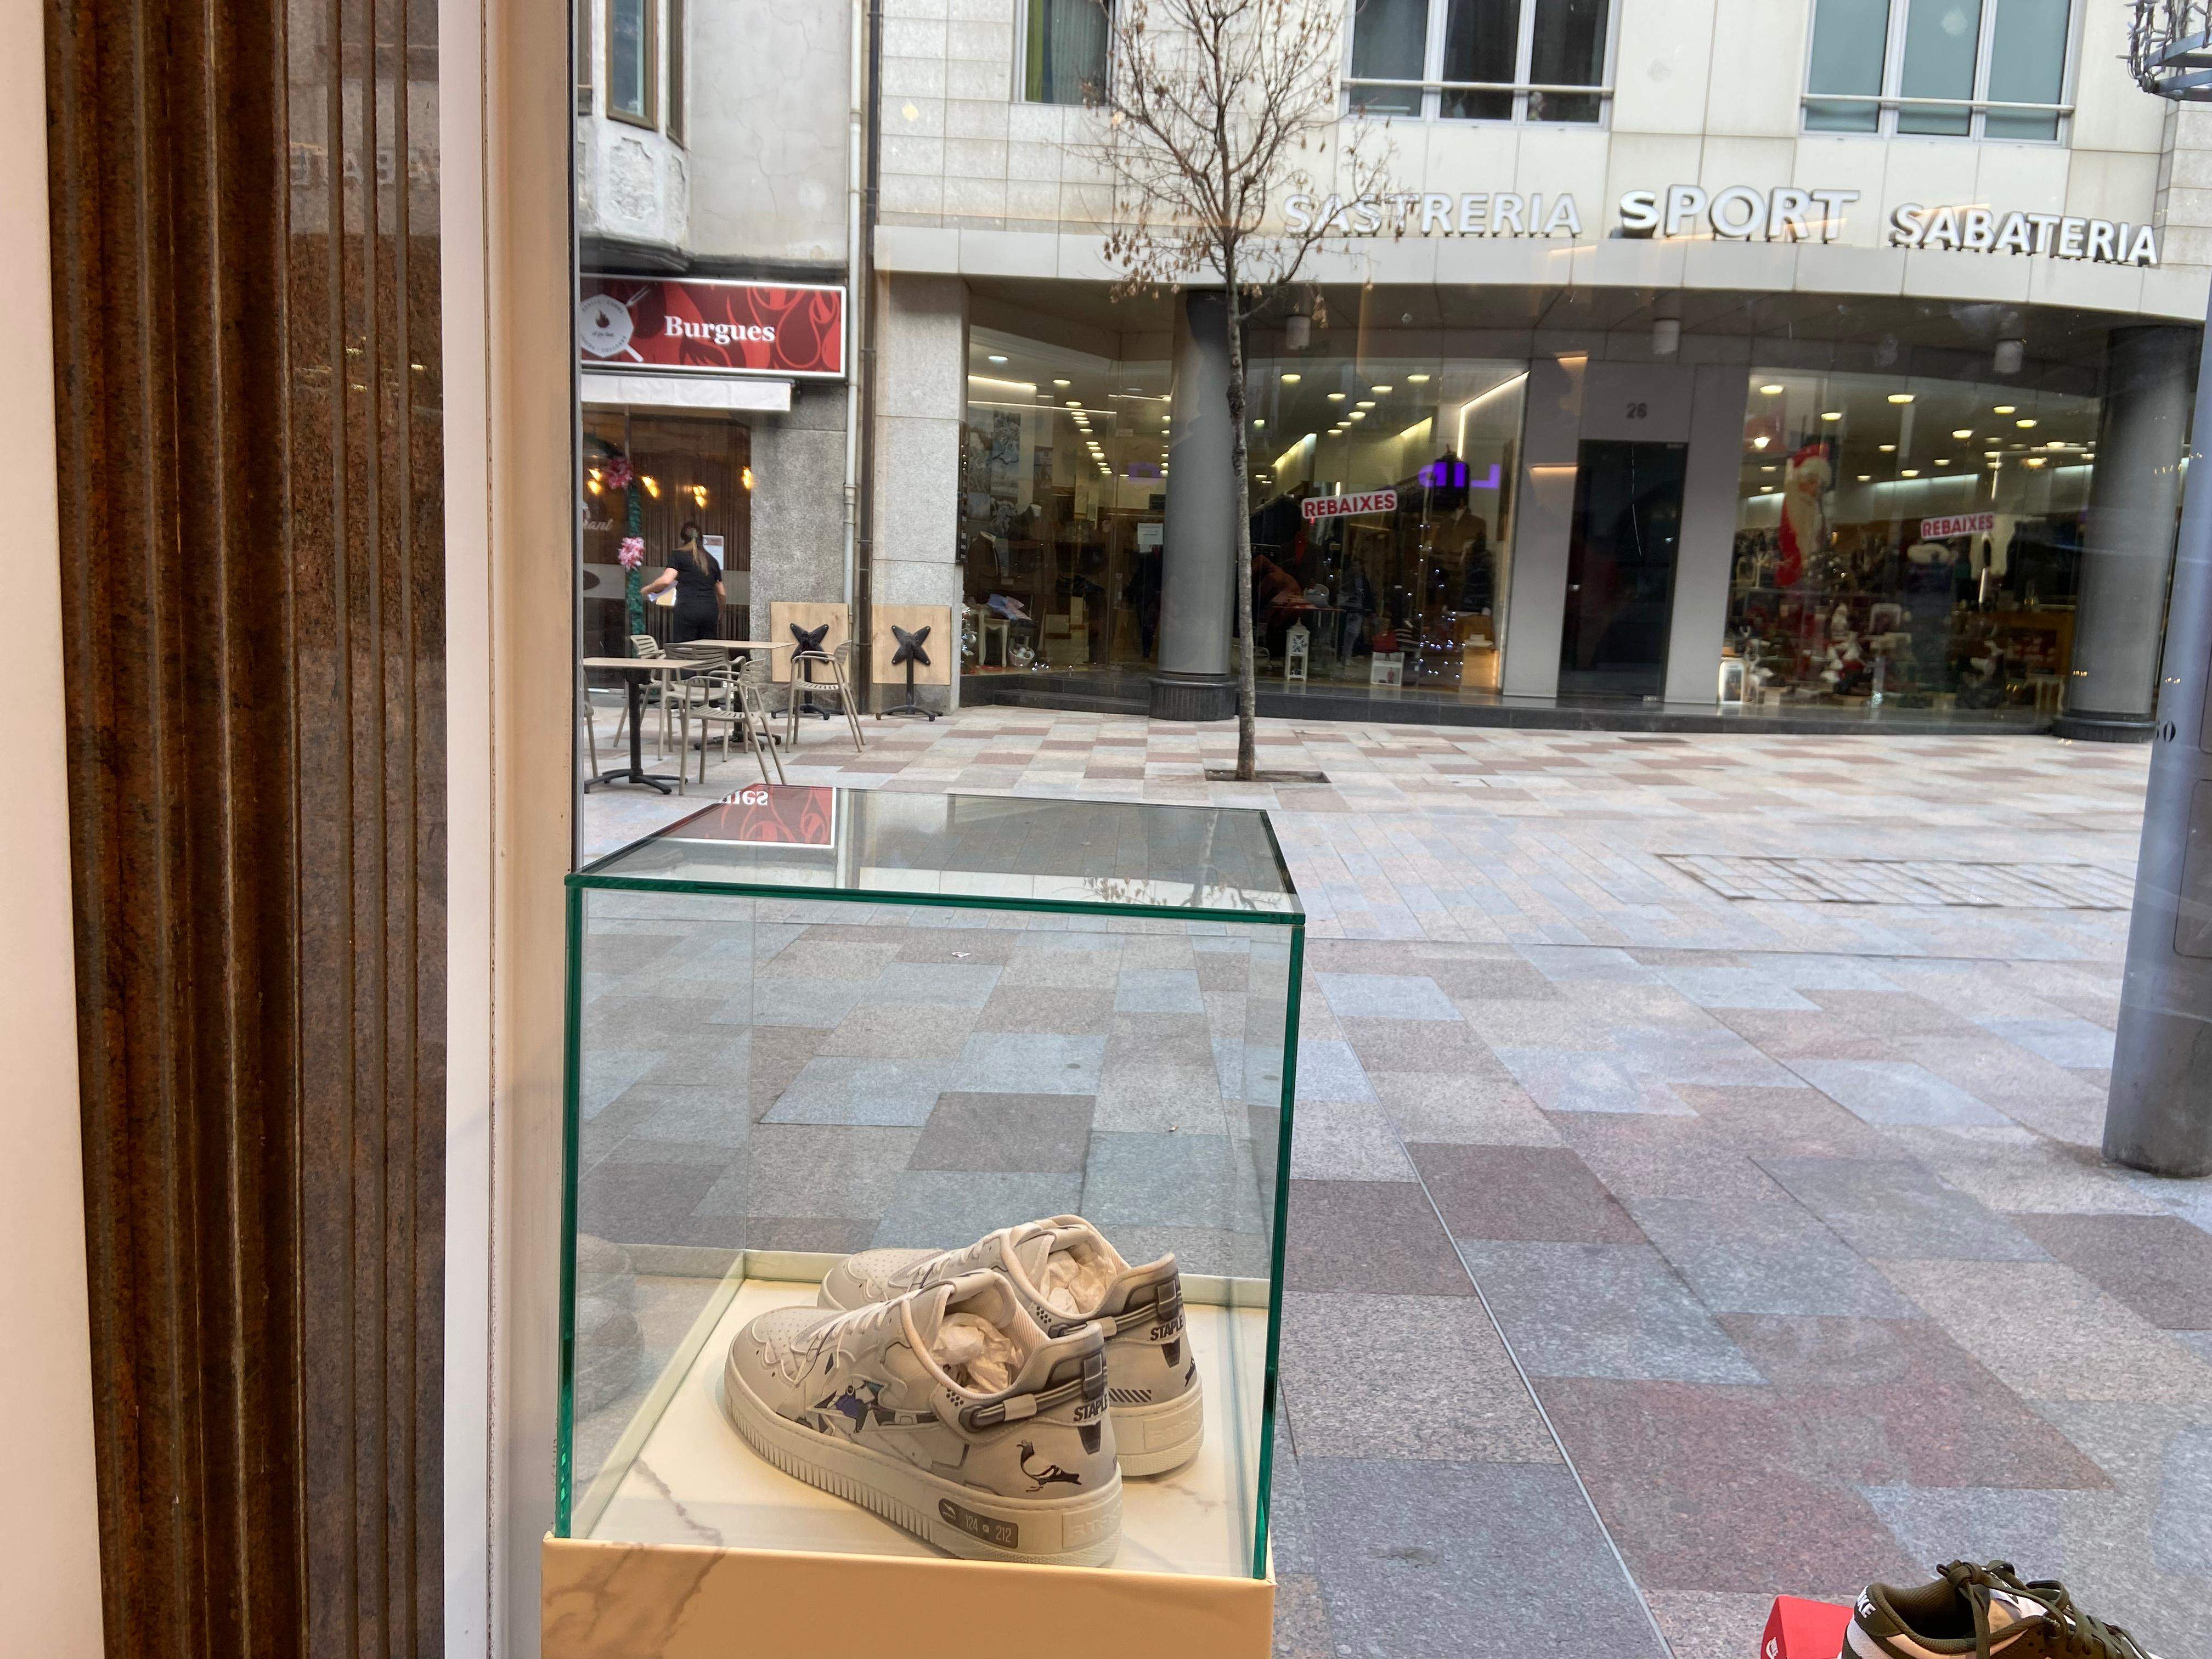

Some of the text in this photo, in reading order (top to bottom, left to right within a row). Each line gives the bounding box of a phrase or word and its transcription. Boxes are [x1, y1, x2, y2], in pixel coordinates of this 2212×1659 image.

[1283, 184, 2158, 264] SASTRERIA SPORT SABATERIA
[664, 315, 776, 345] Burgues
[1626, 402, 1647, 419] 26
[1304, 494, 1395, 517] REBAIXES
[1922, 514, 1993, 537] REBAIXES
[1150, 1314, 1183, 1341] STAPLE
[965, 1514, 979, 1532] 124
[996, 1525, 1012, 1543] 212
